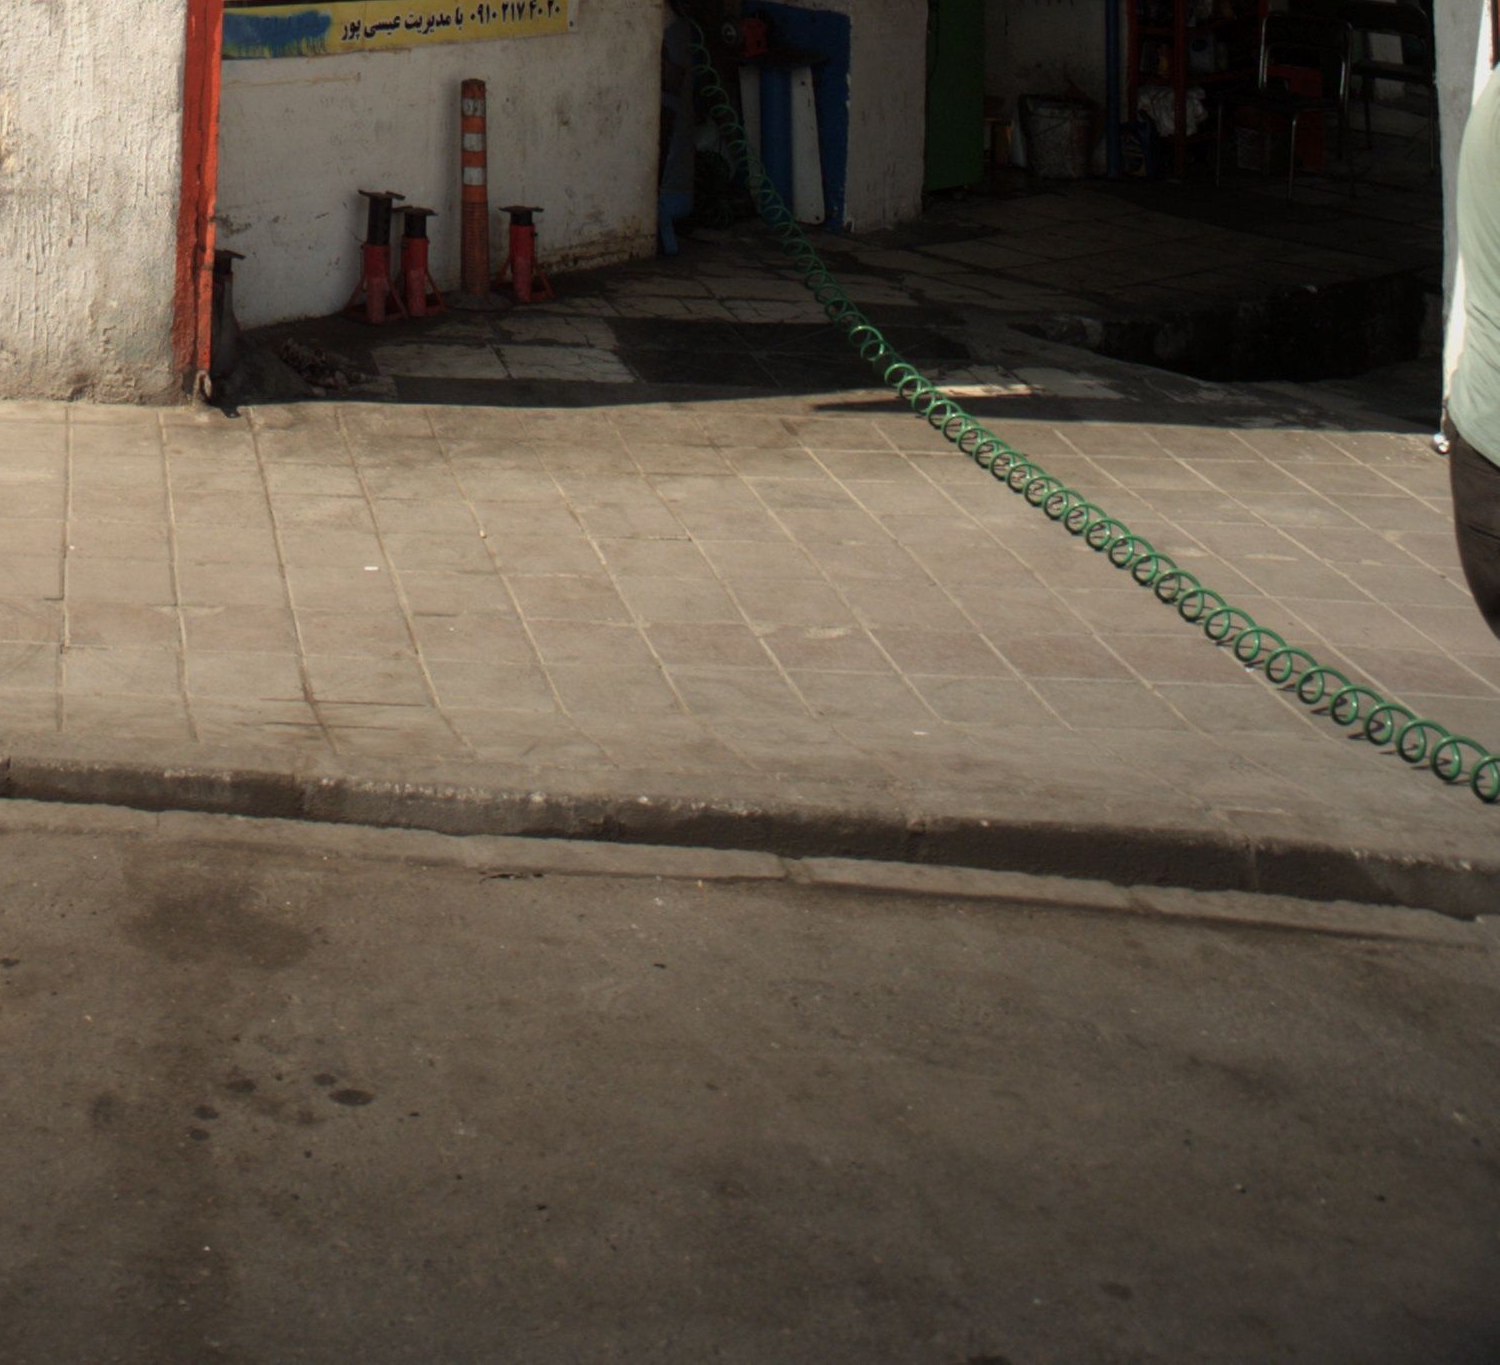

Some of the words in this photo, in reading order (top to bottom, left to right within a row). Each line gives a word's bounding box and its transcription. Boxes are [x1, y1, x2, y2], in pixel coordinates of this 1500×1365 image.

[342, 18, 361, 41] پور
[363, 15, 401, 39] عیسی
[405, 11, 451, 36] مدیریت
